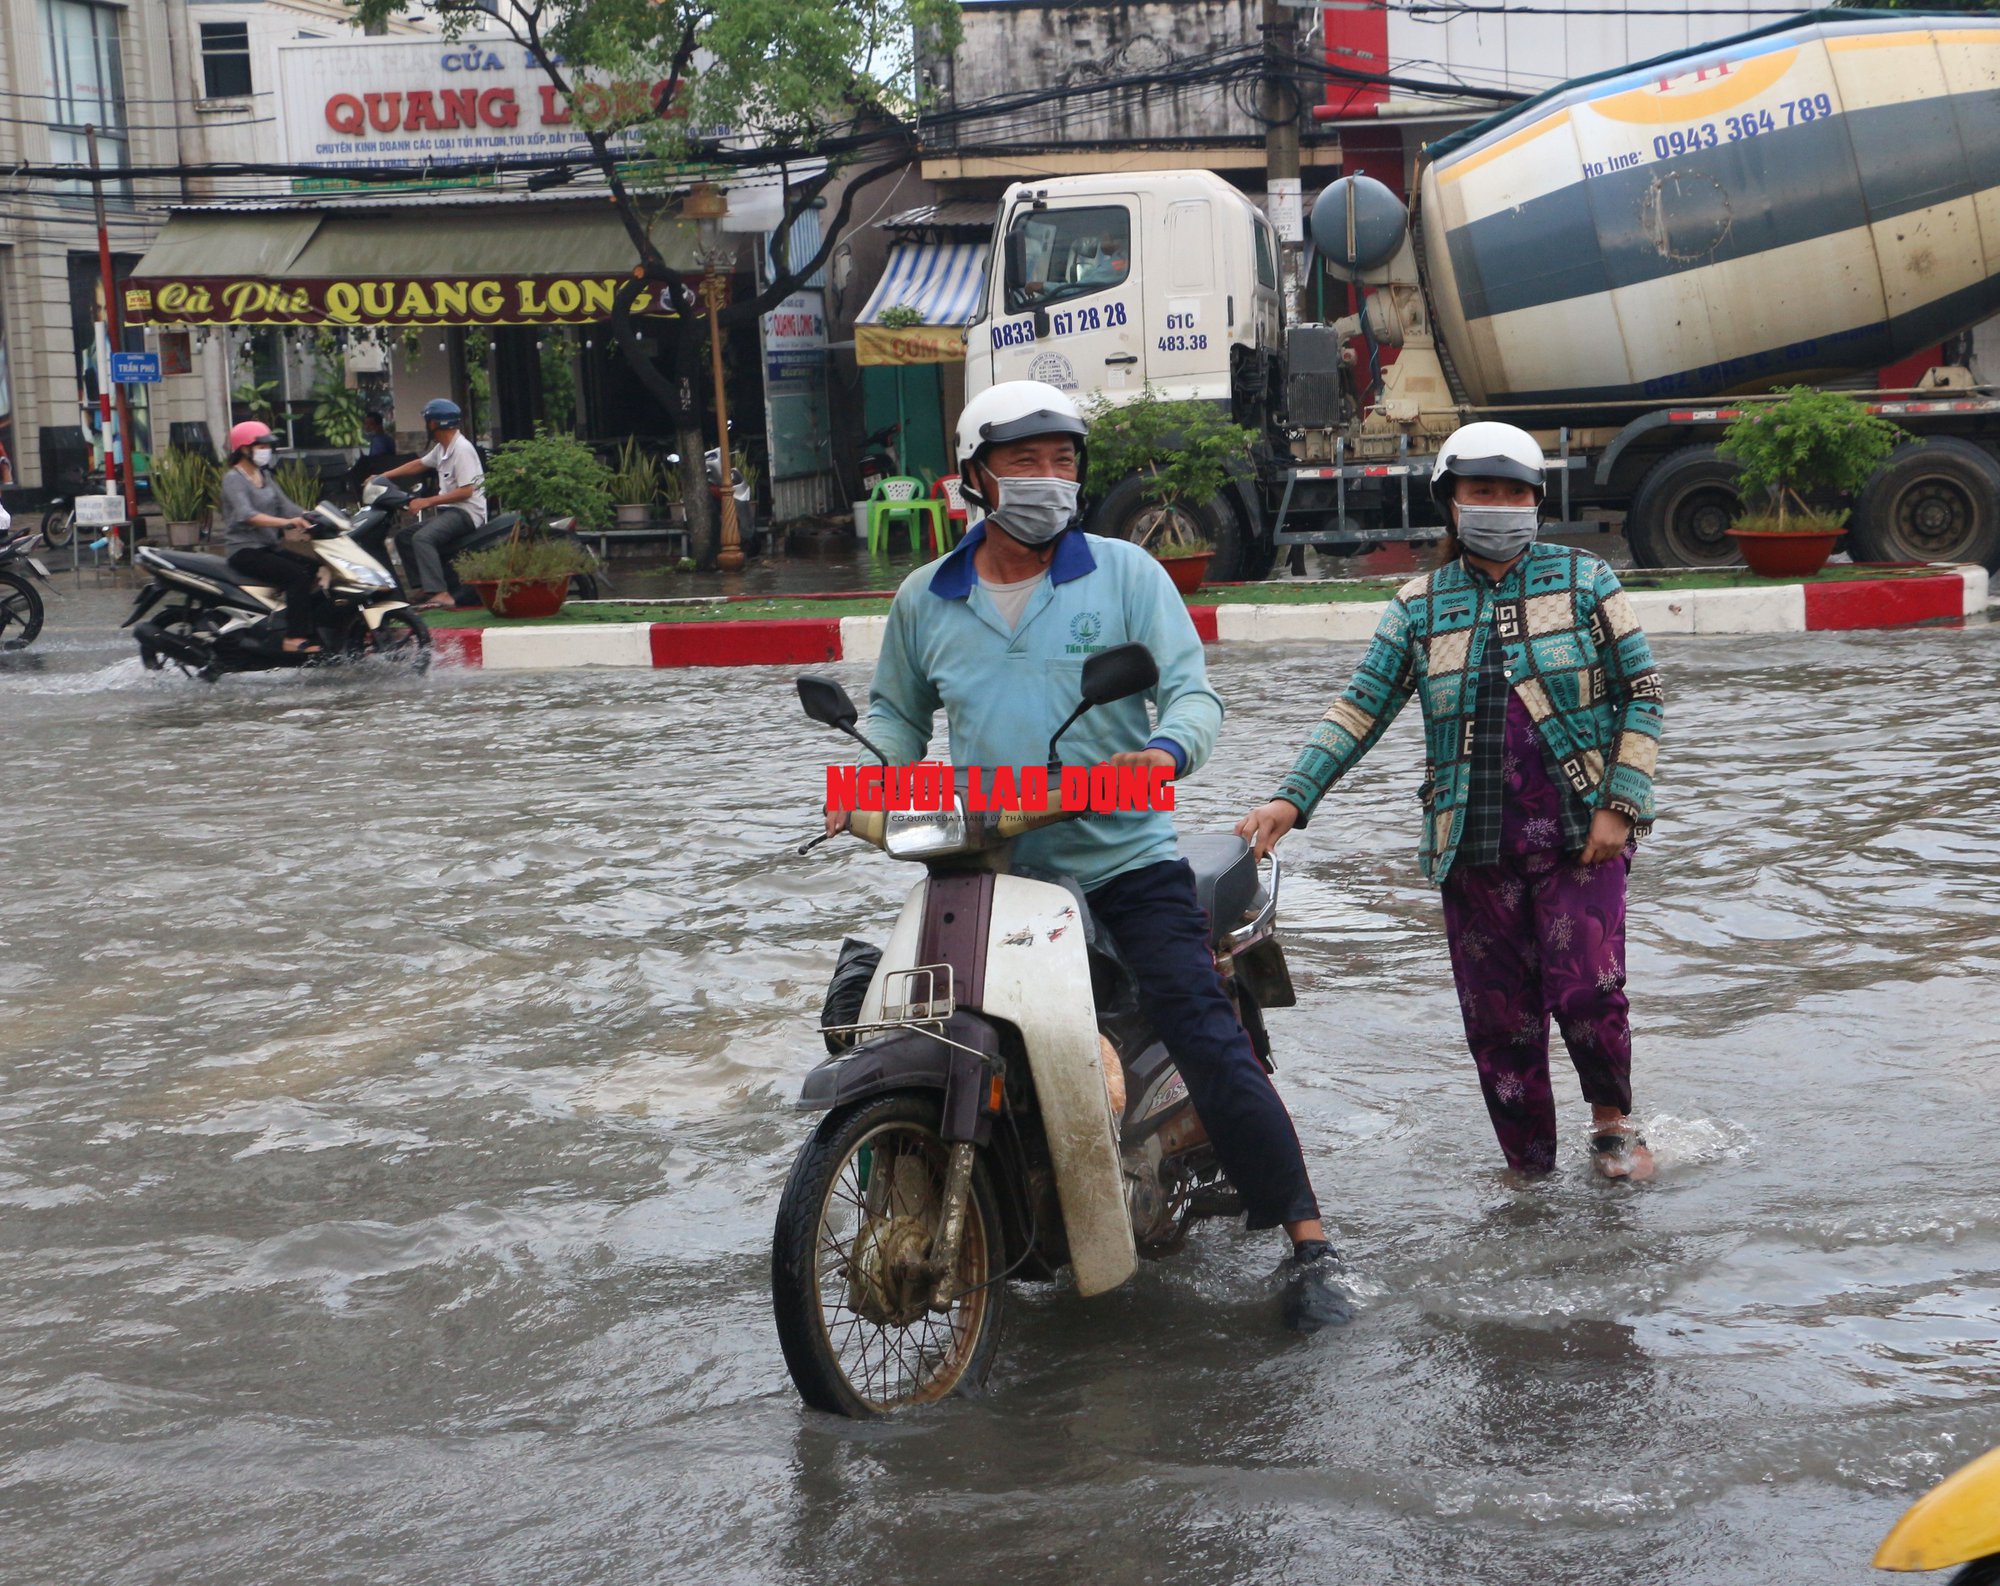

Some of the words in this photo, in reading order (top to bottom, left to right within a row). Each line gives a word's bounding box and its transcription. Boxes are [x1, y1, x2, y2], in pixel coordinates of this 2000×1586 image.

[441, 44, 505, 72] CỬA
[325, 87, 520, 136] QUANG
[1653, 122, 1719, 160] 0943
[1725, 109, 1775, 142] 364
[1780, 93, 1832, 126] 789
[315, 142, 352, 154] CHUYÊN
[355, 141, 377, 153] KINH
[380, 139, 410, 152] DOANH
[413, 137, 433, 150] CÁC
[156, 282, 214, 314] Cà
[222, 281, 311, 319] Phê
[324, 281, 506, 323] QUANG
[992, 320, 1036, 350] 0833
[1053, 312, 1073, 336] 67
[1077, 307, 1101, 331] 28
[1104, 302, 1128, 327] 28
[1158, 335, 1208, 351] 483.38
[1441, 596, 1469, 605] adidas
[1472, 626, 1487, 665] FASHION
